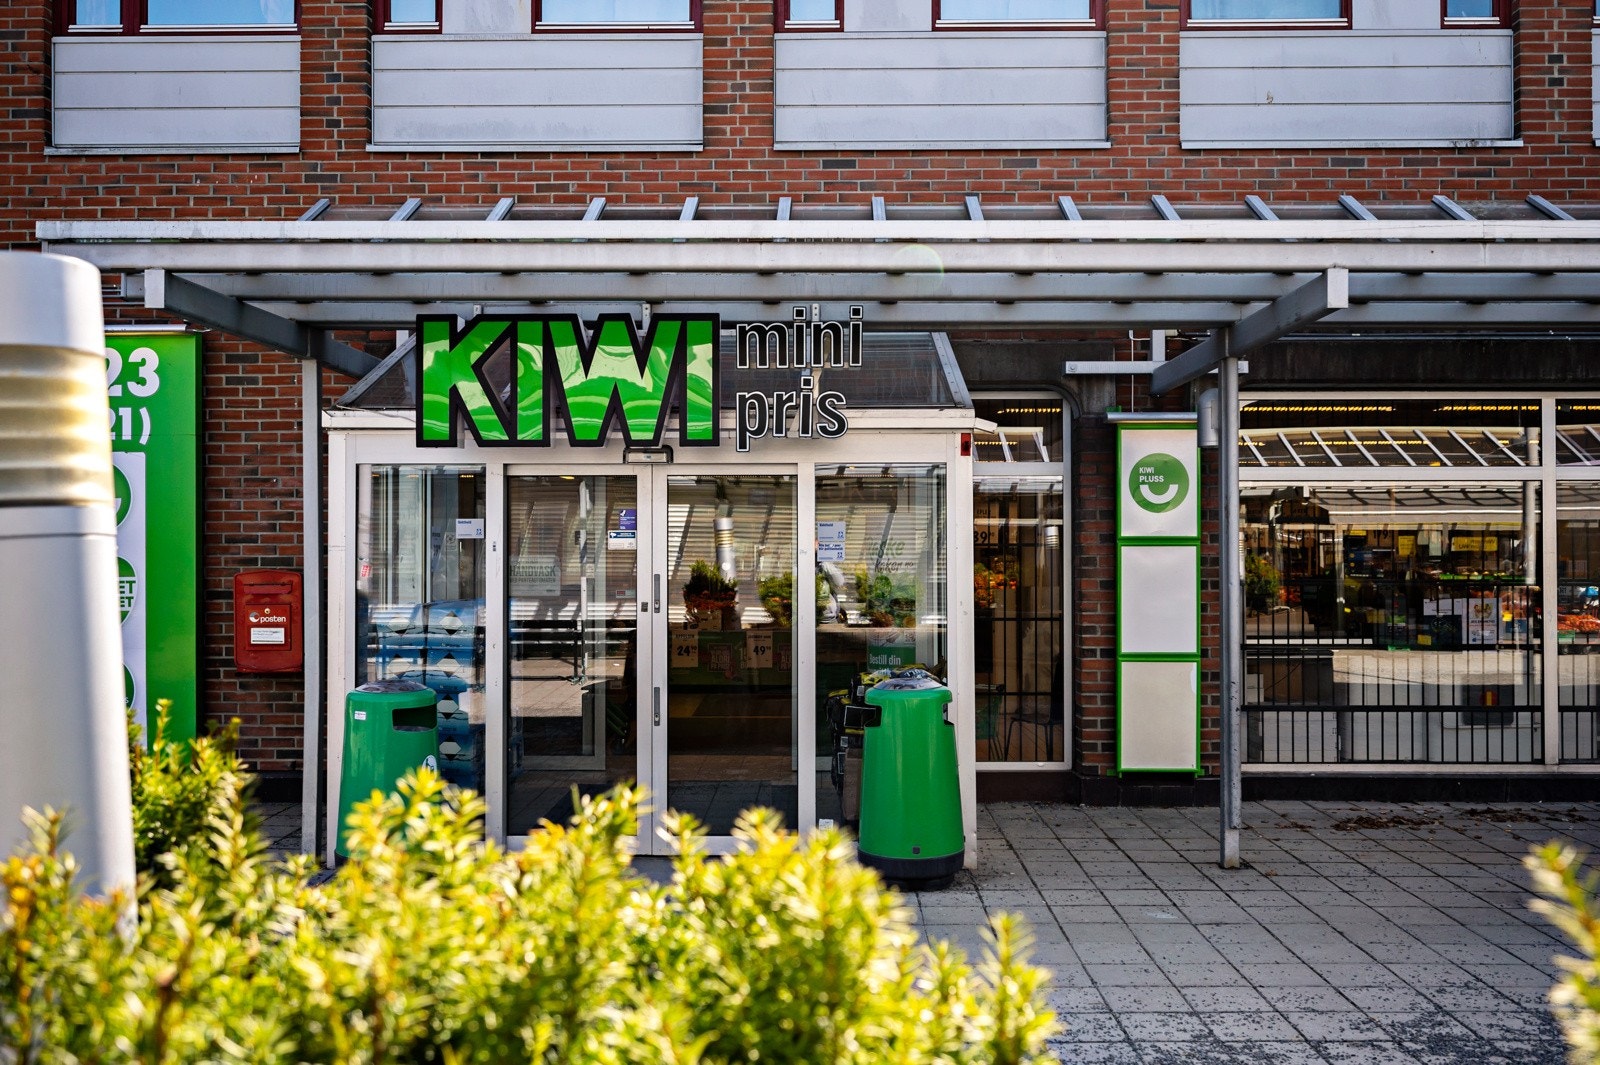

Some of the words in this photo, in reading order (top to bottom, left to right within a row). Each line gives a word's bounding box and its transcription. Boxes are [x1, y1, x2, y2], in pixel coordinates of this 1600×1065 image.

[105, 347, 160, 397] 23
[416, 313, 720, 447] KIWI
[736, 305, 863, 369] mini
[736, 376, 848, 452] pris
[1139, 475, 1164, 483] PLUSS
[260, 615, 287, 624] posten
[677, 645, 690, 656] 24
[753, 645, 766, 656] 49
[888, 654, 901, 665] din
